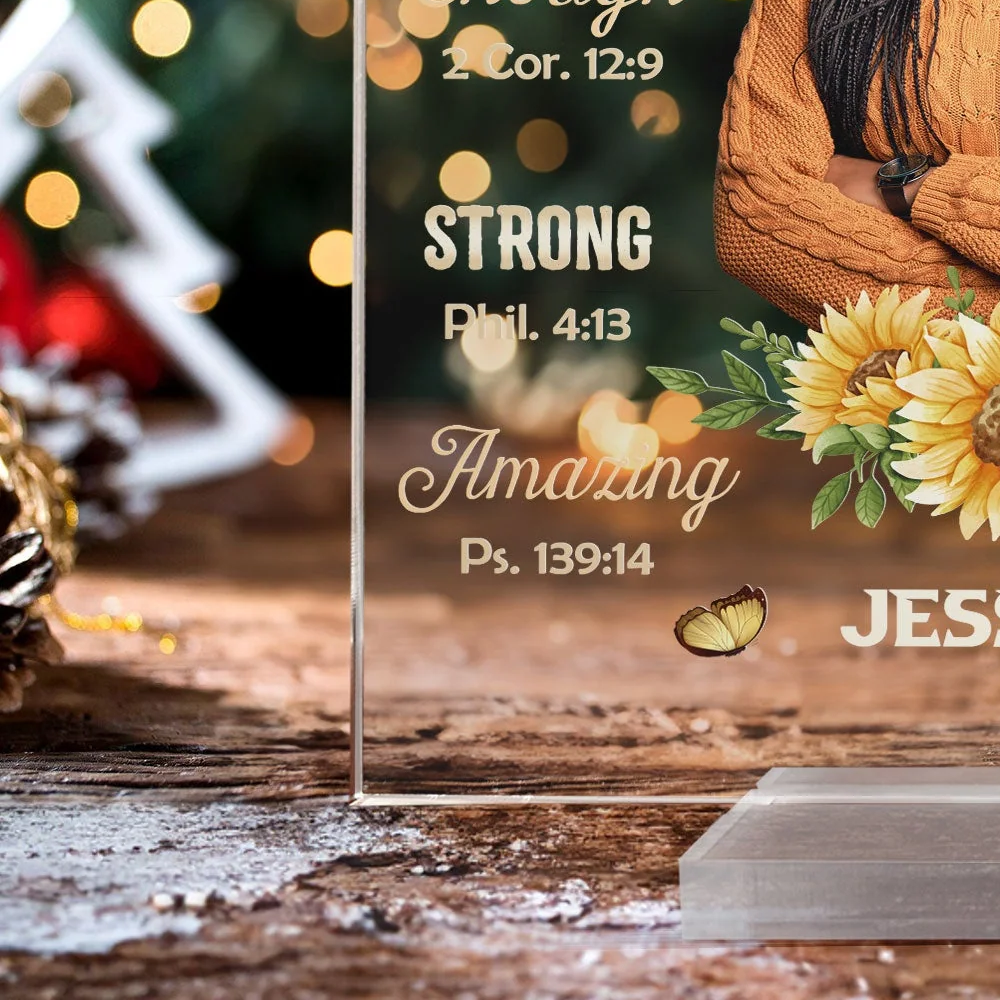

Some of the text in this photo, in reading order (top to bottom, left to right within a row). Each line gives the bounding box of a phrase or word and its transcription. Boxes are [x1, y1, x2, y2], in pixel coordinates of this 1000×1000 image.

[442, 43, 665, 81] 2 Cor. 12:9
[424, 203, 652, 271] STRONG
[444, 302, 631, 341] Phil. 4:13
[398, 423, 738, 532] Amazing
[460, 536, 655, 576] Ps. 139:14
